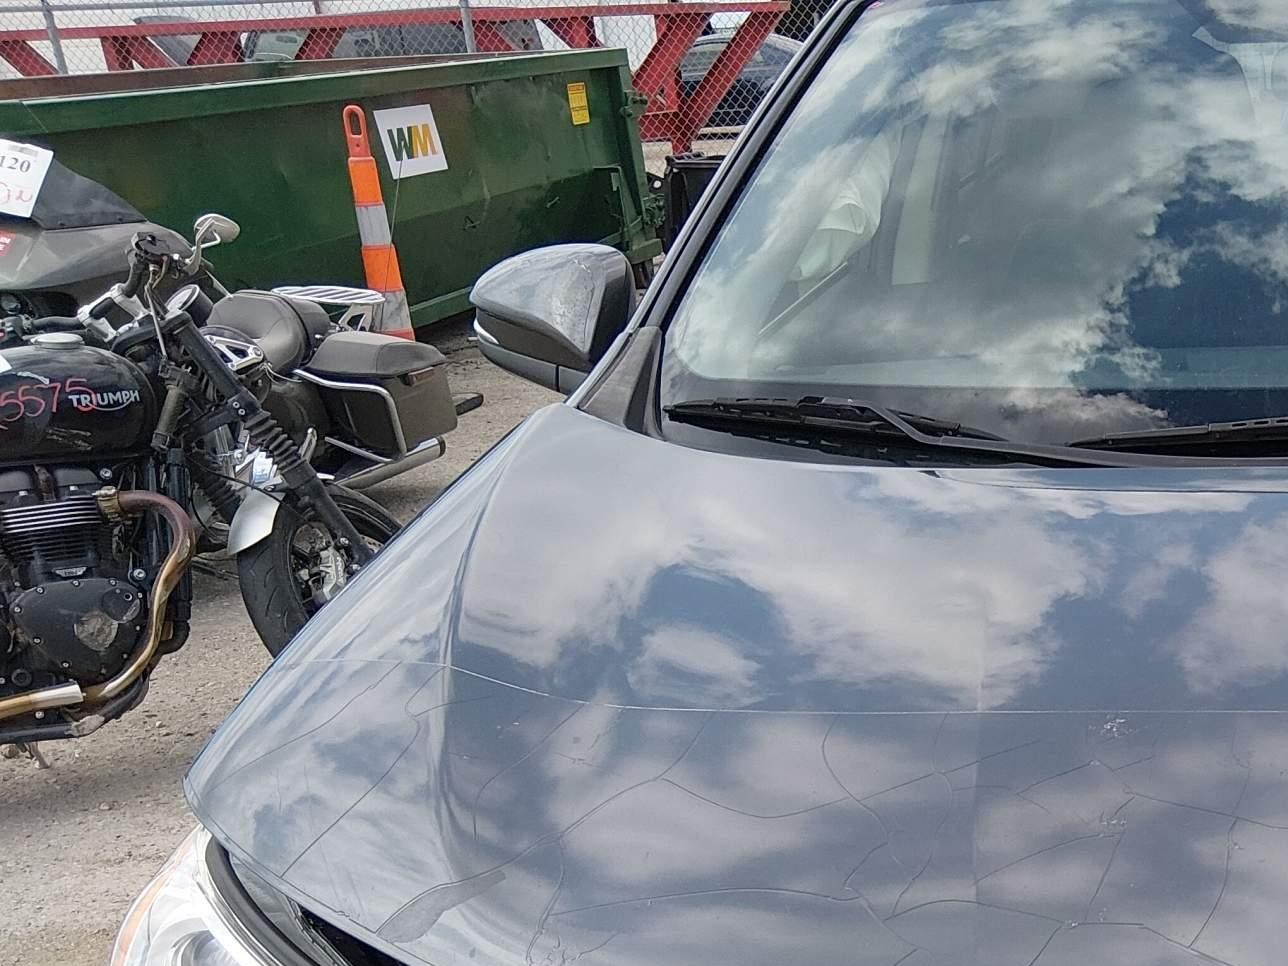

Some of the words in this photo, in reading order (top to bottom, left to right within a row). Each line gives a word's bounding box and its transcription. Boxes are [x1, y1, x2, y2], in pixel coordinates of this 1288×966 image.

[387, 124, 438, 162] WM
[0, 378, 94, 430] 5575
[68, 390, 140, 411] TRIUMPH
